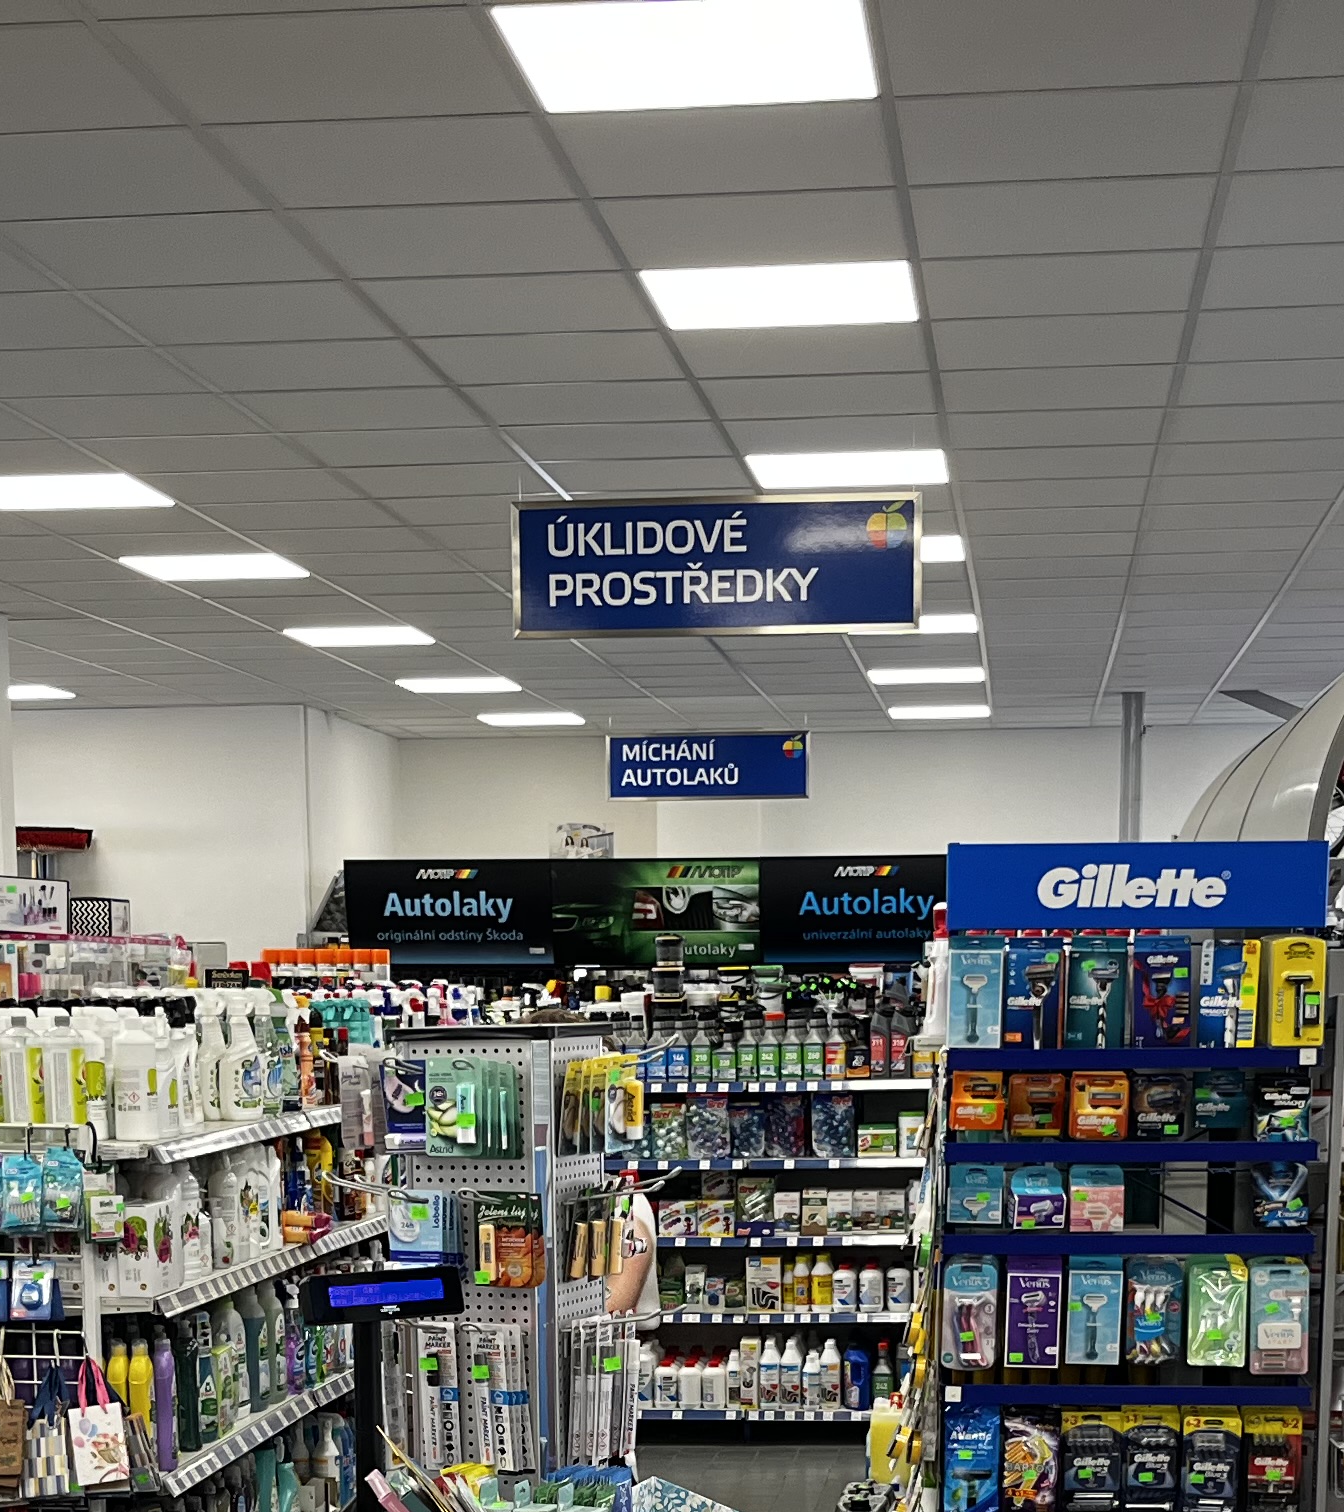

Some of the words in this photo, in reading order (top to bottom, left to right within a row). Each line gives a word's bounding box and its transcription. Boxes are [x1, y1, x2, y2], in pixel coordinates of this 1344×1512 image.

[548, 511, 747, 558] ÚKLIDOVÉ
[548, 563, 819, 608] PROSTŘEDKY
[621, 739, 715, 762] MÍCHÁNÍ
[621, 764, 739, 787] AUTOLAKŮ
[1037, 864, 1226, 909] Gillette
[383, 891, 513, 923] Autolaky
[799, 888, 934, 920] Autolaky
[377, 928, 435, 944] originální
[439, 928, 483, 944] odstíny
[486, 926, 523, 941] Škoda
[803, 927, 872, 941] univerzální
[875, 927, 931, 943] autolaky
[682, 942, 736, 958] utolaky
[429, 1144, 454, 1155] Astrid
[1019, 1277, 1050, 1289] Venus
[425, 1341, 452, 1350] MARKER
